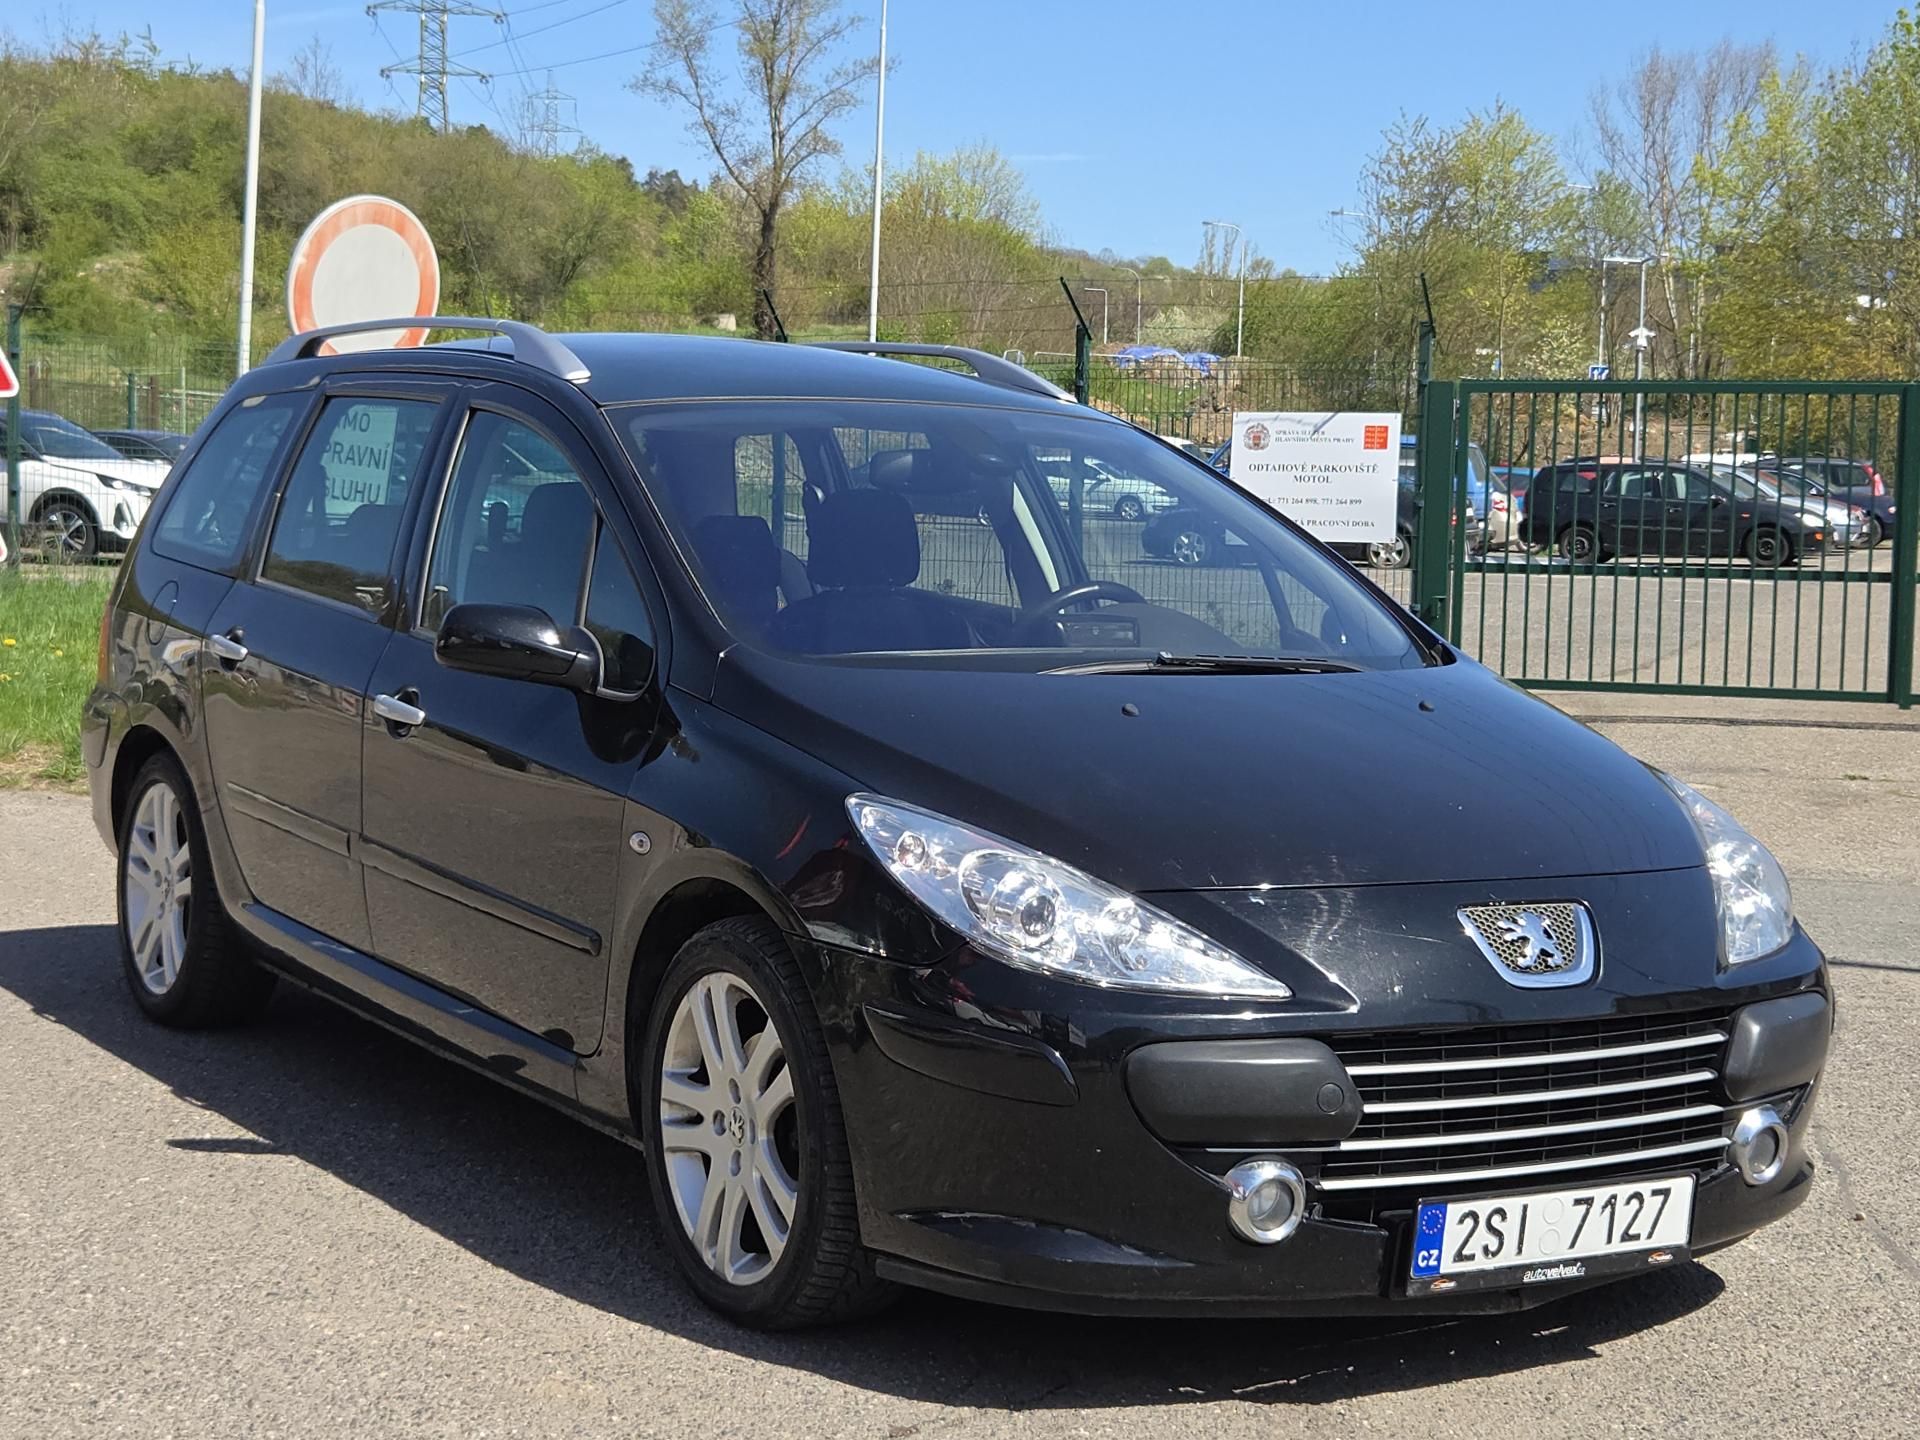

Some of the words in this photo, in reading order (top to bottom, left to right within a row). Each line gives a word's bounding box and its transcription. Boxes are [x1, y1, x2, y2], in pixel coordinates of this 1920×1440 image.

[341, 411, 370, 432] MO
[1248, 462, 1306, 472] ODTAHOVÉ
[1310, 463, 1379, 473] PARKOVIŠTĚ
[1293, 475, 1332, 484] MOTOL
[1306, 519, 1350, 527] PRACOVNÍ
[1351, 520, 1375, 528] DOBA
[1452, 1203, 1529, 1264] 2SI
[1568, 1187, 1672, 1250] 7127
[1417, 1250, 1439, 1268] CZ
